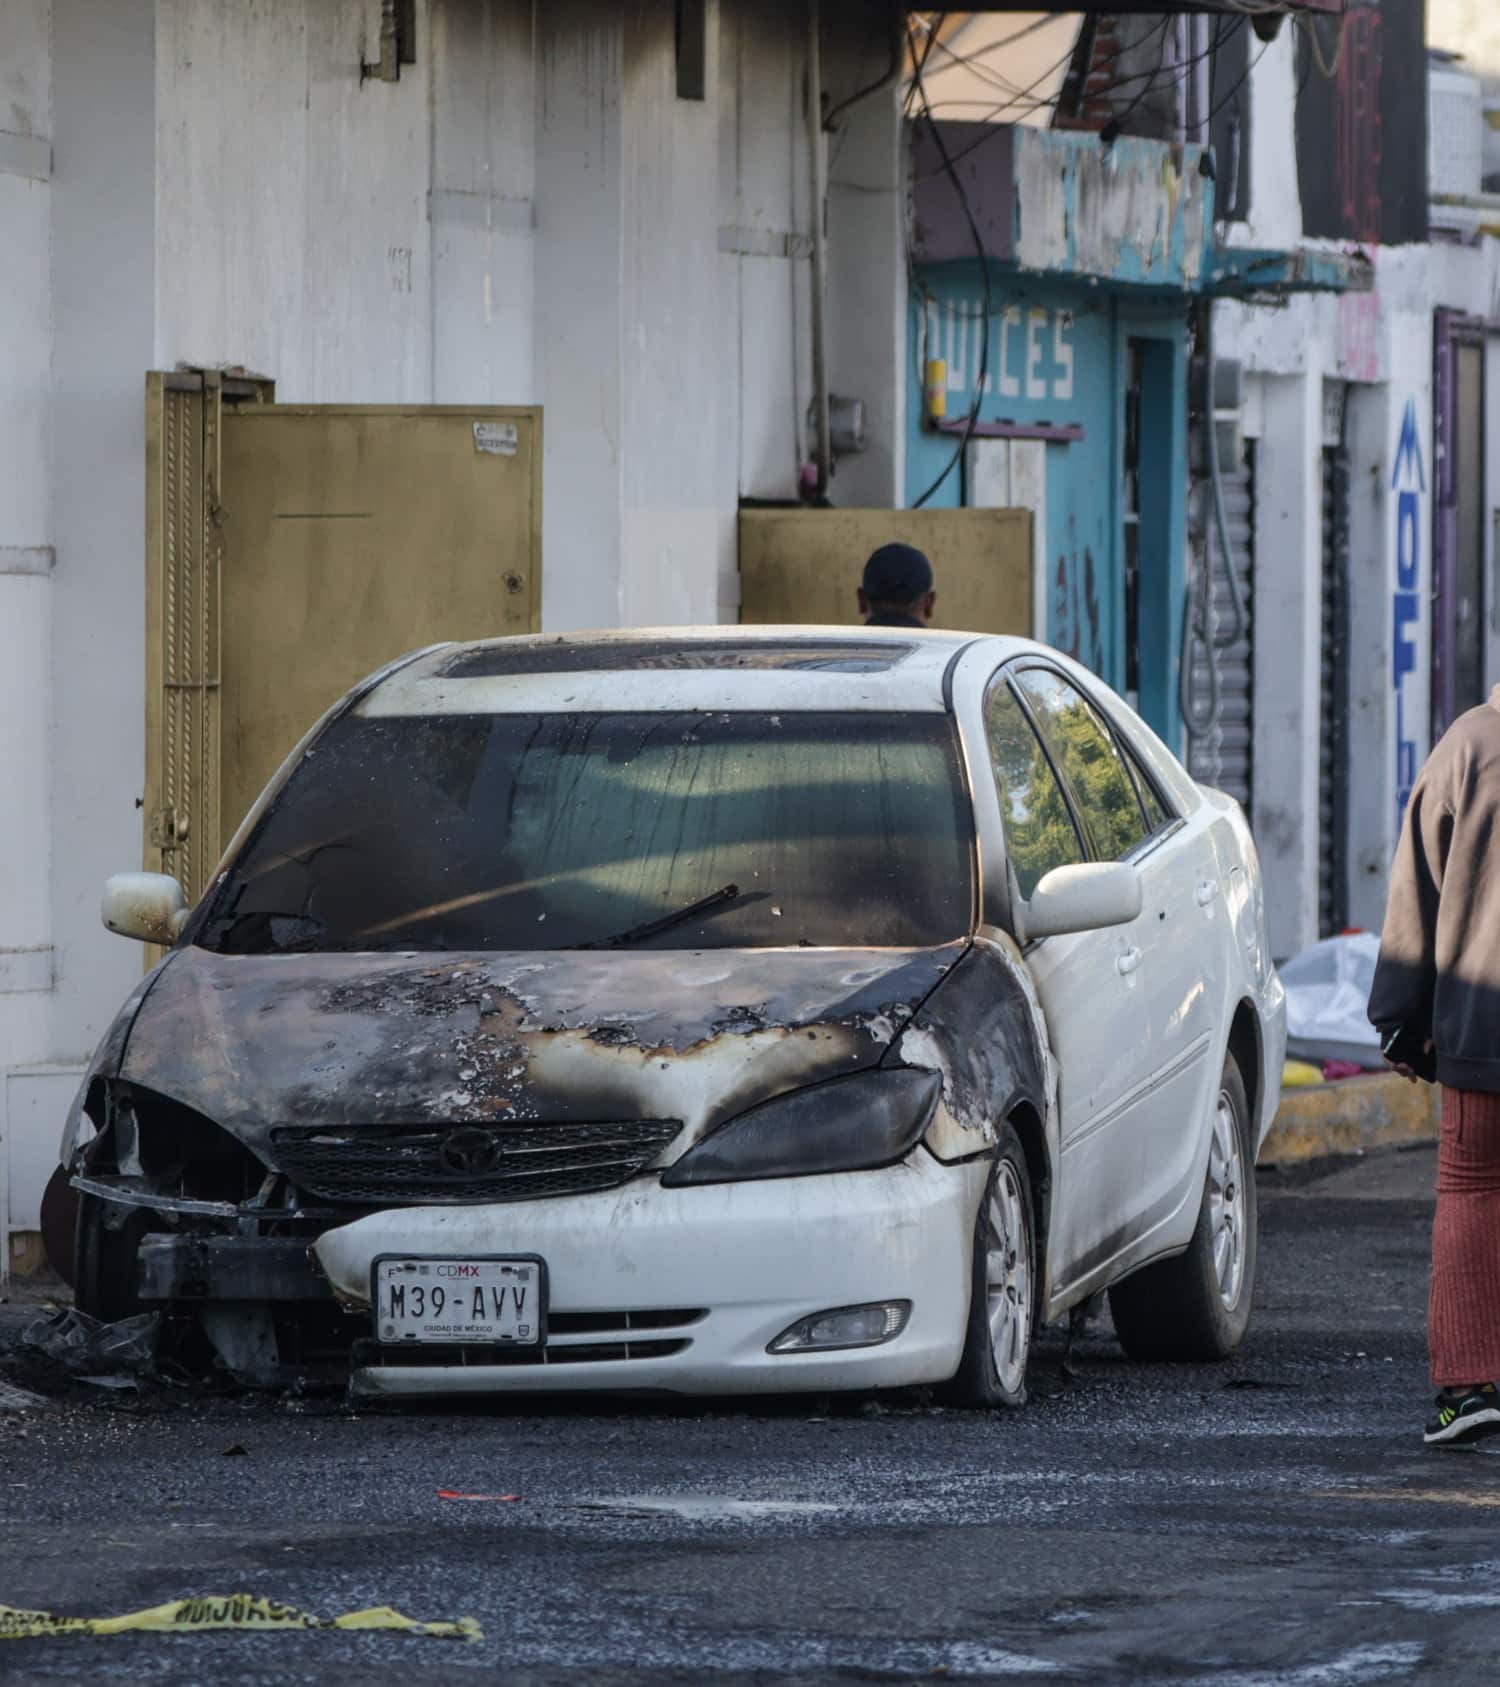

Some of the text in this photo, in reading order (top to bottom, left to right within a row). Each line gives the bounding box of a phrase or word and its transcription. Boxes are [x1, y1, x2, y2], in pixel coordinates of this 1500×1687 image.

[917, 299, 1074, 399] DULCES
[437, 1264, 480, 1277] CDMX
[423, 1324, 452, 1333] CIUDAD
[453, 1324, 463, 1333] DE
